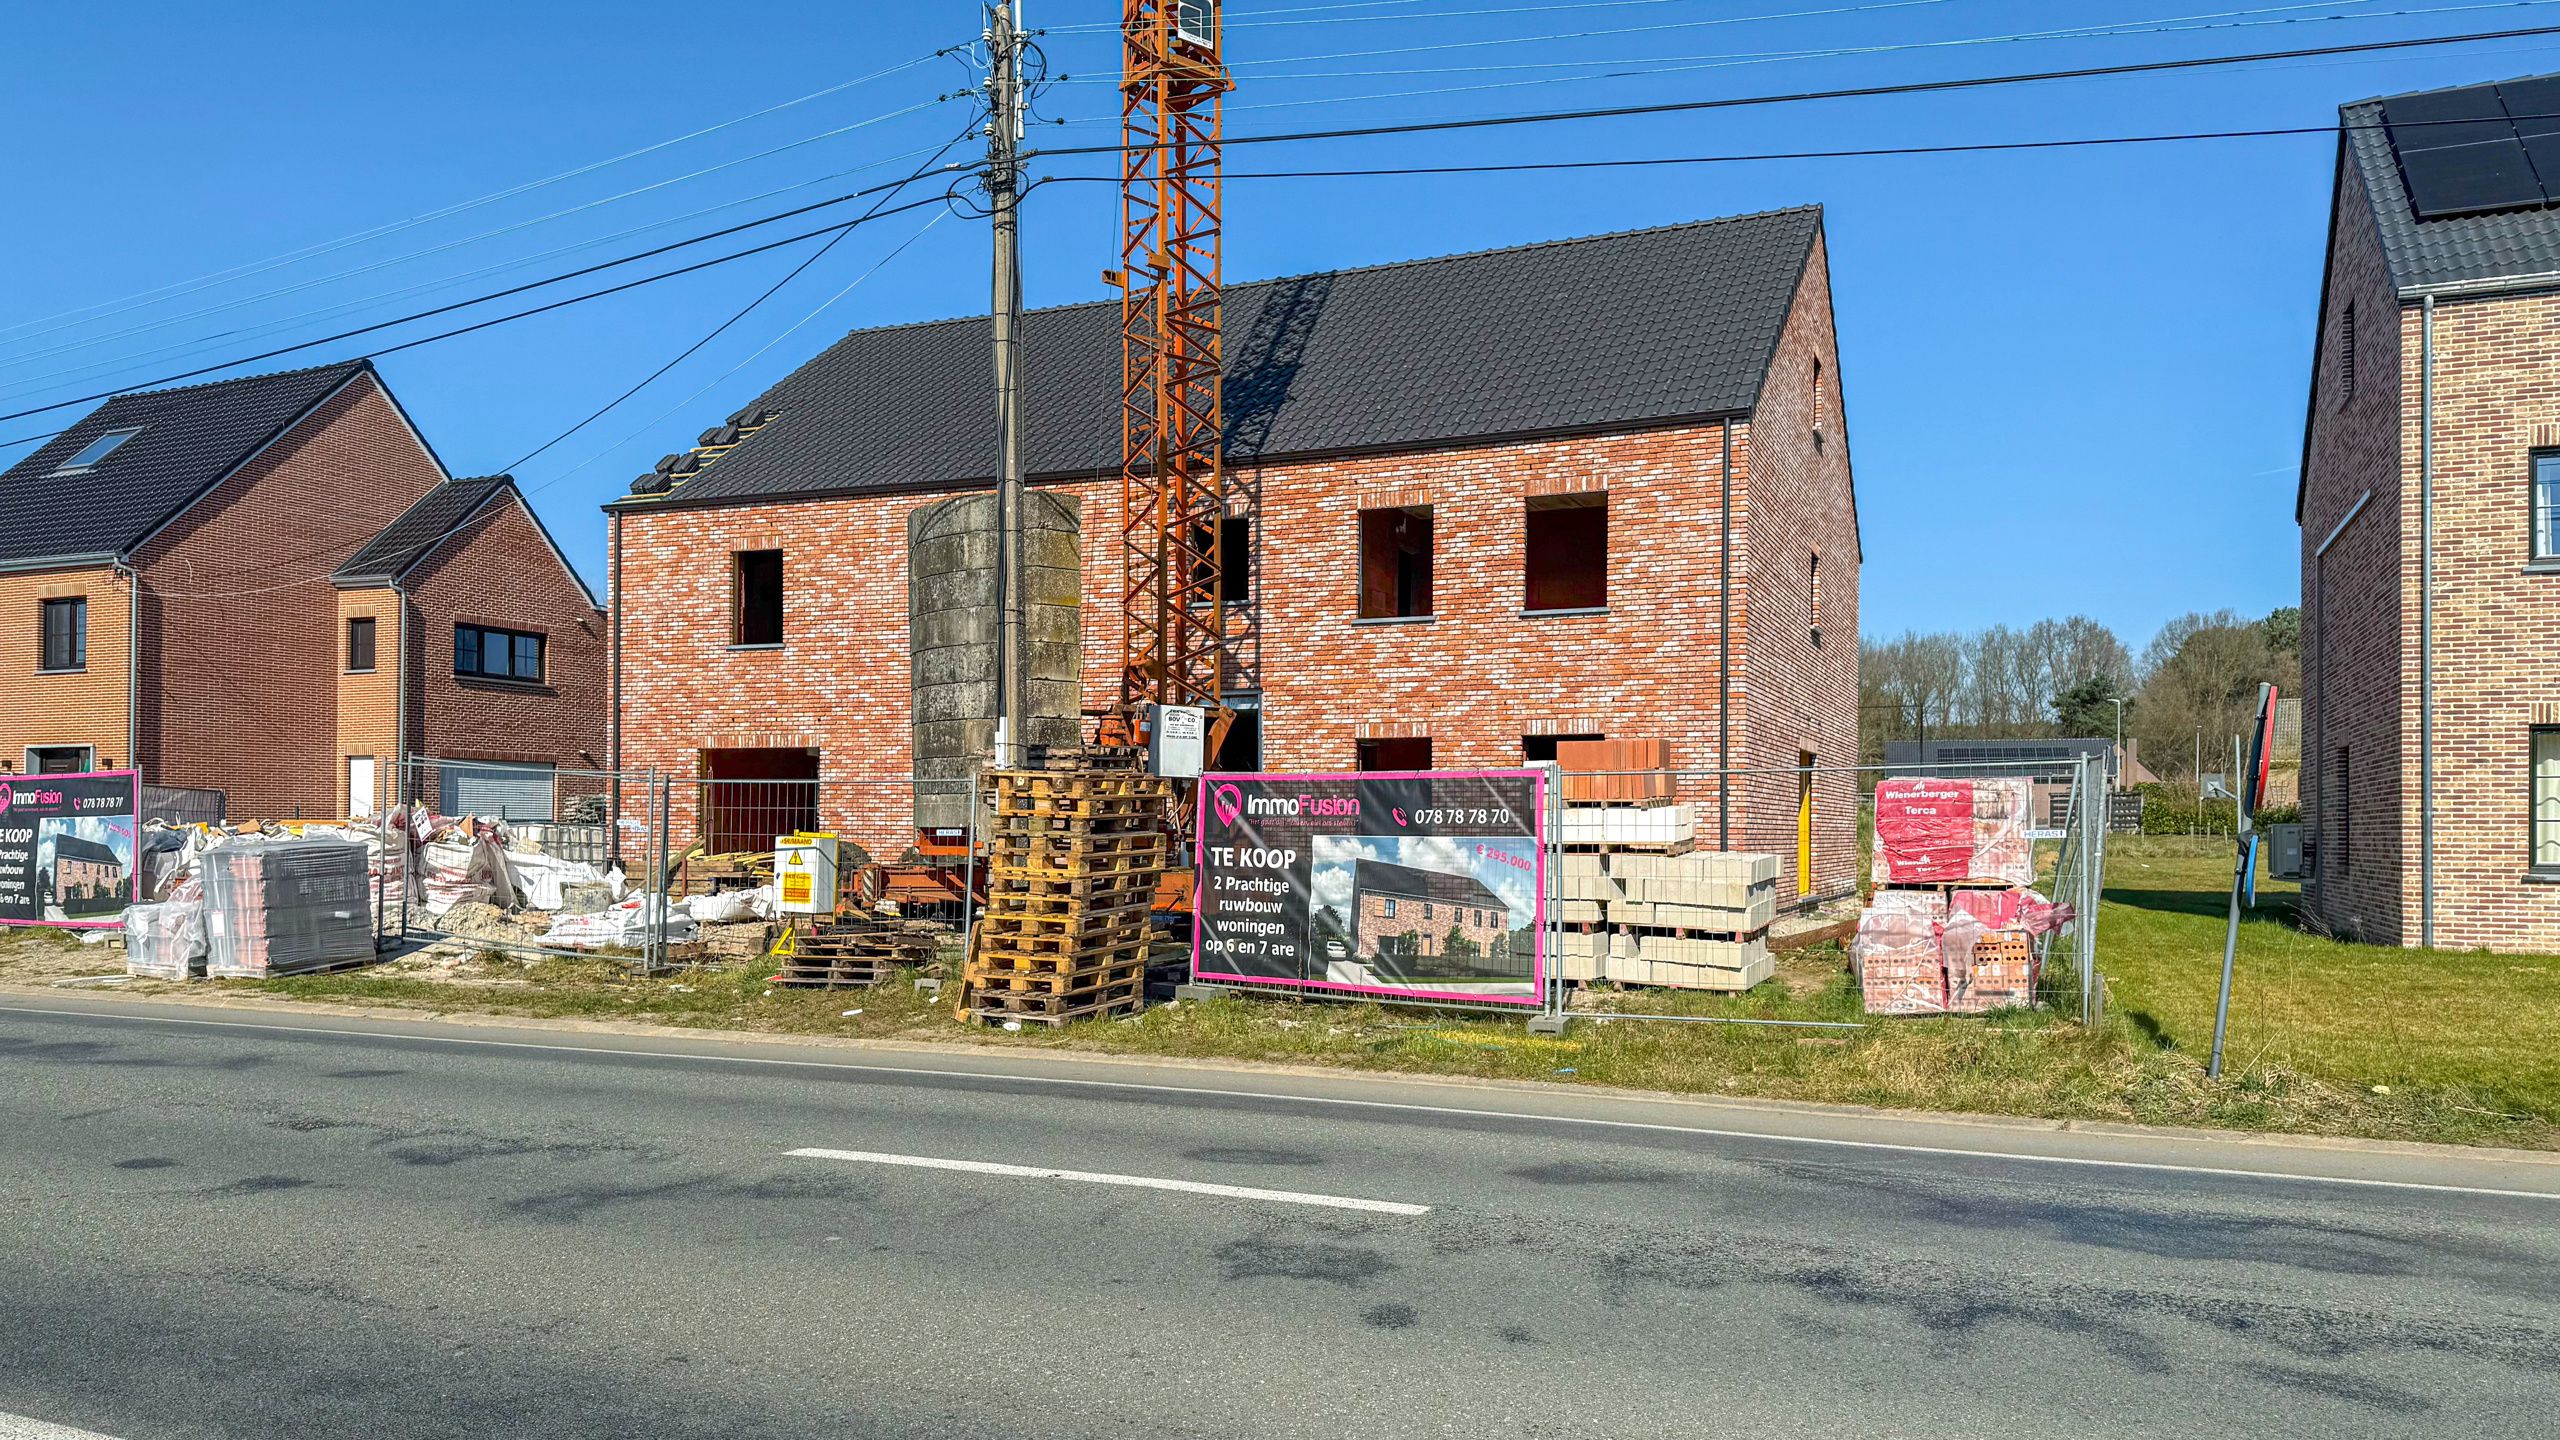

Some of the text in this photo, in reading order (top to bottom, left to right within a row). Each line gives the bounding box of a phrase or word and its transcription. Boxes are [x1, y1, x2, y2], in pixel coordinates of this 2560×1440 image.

[12, 788, 63, 805] ImmoFusion
[1885, 789, 1960, 800] Wienerberger
[1247, 794, 1361, 816] ImmoFusion
[1904, 805, 1937, 815] Terca
[1414, 808, 1510, 825] 078 78 78 70
[0, 828, 33, 843] E KOOP
[2023, 830, 2060, 838] HERAS
[1211, 847, 1297, 869] TE KOOP
[1475, 843, 1532, 872] € 295.000
[0, 878, 25, 892] oningen
[1213, 876, 1290, 896] 2 Prachtige
[13, 893, 19, 904] 7
[1219, 897, 1283, 914] ruwbouw
[1216, 918, 1285, 937] woningen
[1205, 939, 1295, 957] op 6 en 7 are
